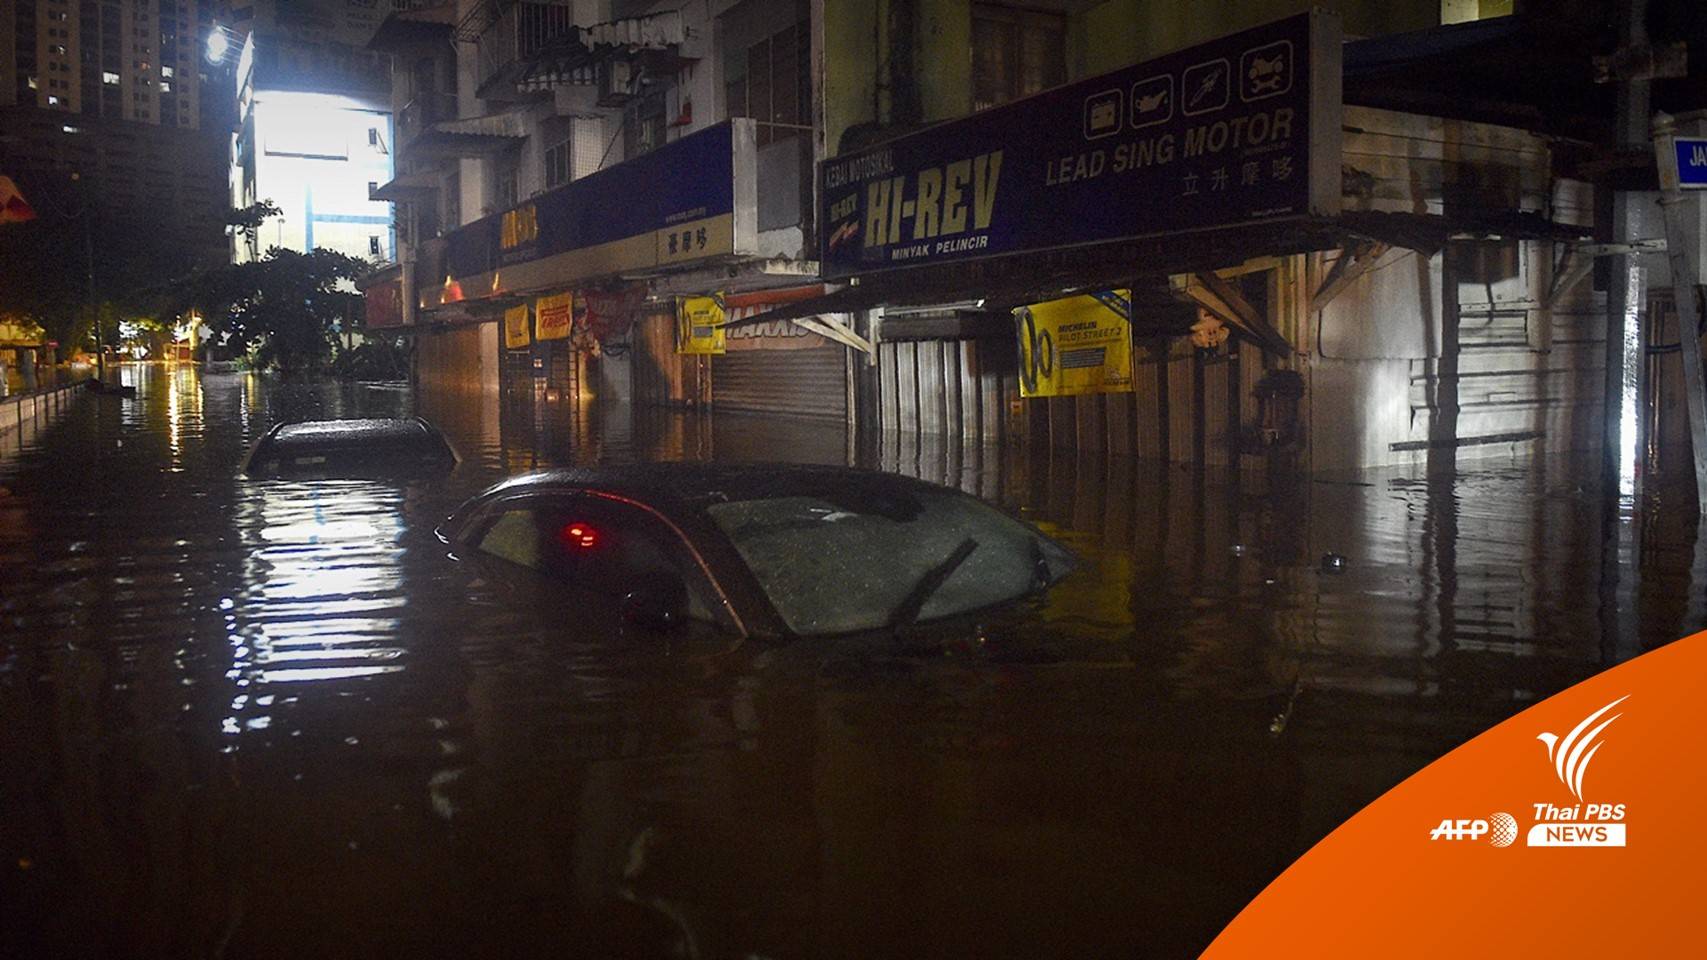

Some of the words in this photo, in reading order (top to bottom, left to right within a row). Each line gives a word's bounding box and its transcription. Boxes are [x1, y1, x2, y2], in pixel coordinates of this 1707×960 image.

[1046, 149, 1106, 186] LEAD
[1112, 134, 1175, 174] SING
[1184, 108, 1294, 158] MOTOR
[1689, 144, 1707, 167] JA
[864, 150, 1004, 248] HI-REV
[891, 244, 929, 260] MINYAK
[935, 235, 989, 254] PELINCIR
[1058, 320, 1097, 333] MICHELIN
[1058, 332, 1081, 342] PILOT
[1083, 328, 1115, 340] STREET
[1116, 327, 1122, 336] 2
